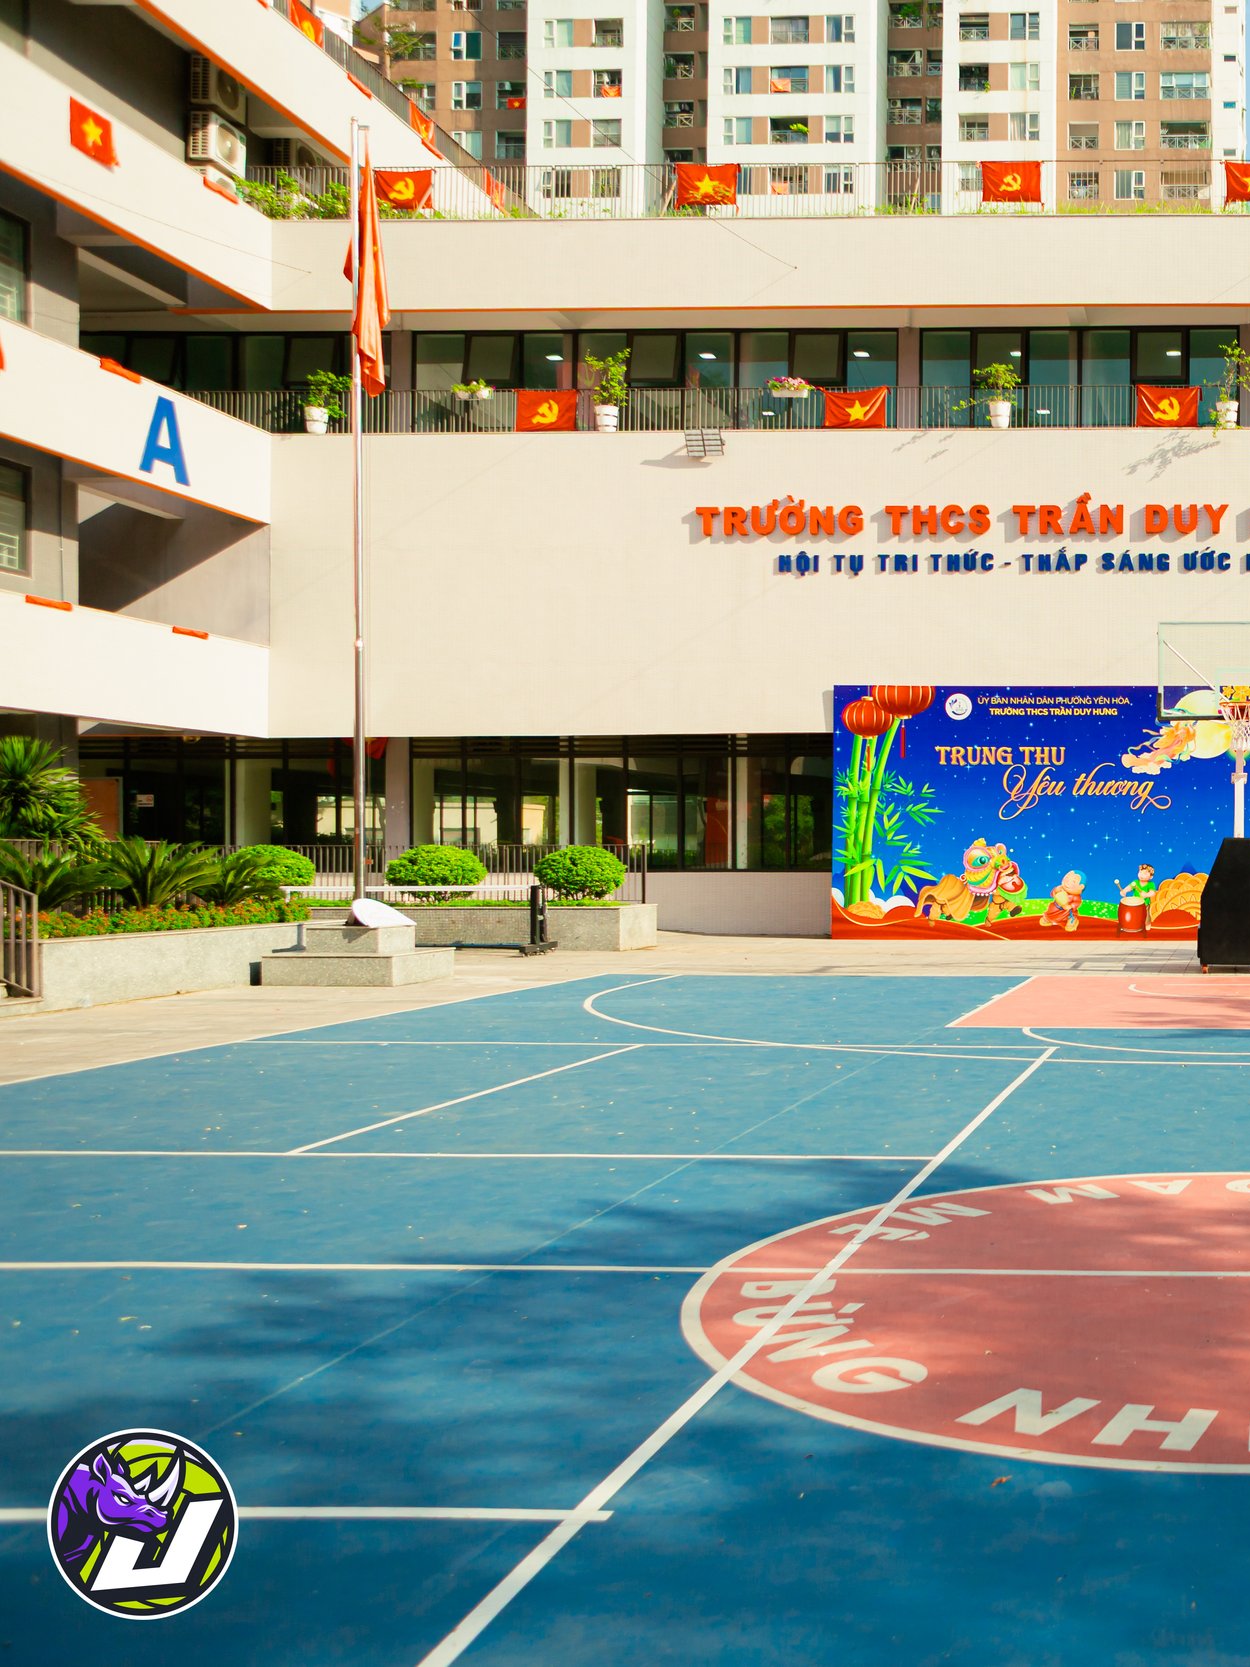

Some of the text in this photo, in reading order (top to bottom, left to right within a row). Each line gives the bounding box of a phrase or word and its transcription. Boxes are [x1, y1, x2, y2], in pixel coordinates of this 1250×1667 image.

[139, 395, 190, 487] A
[696, 495, 864, 536] TRƯỜNG
[885, 505, 990, 535] THCS
[1013, 492, 1124, 534] TRẦN
[1145, 504, 1229, 534] DUY
[778, 551, 819, 576] HỘI
[833, 555, 863, 576] TỤ
[877, 555, 918, 572] TRI
[930, 548, 994, 572] THỨC
[1022, 546, 1087, 571] THẮP
[1102, 549, 1169, 571] SÁNG
[1183, 547, 1230, 571] ƯỚC
[977, 695, 1130, 705] ỦY BAN NHÂN DÂN PHƯỜNG YÊN HÒA
[989, 706, 1118, 716] TRƯỜNG THCS TRẦN DUY HƯNG
[935, 745, 1066, 766] TRUNG THU
[999, 762, 1172, 820] Yêu thương
[828, 1202, 992, 1242] MÊ
